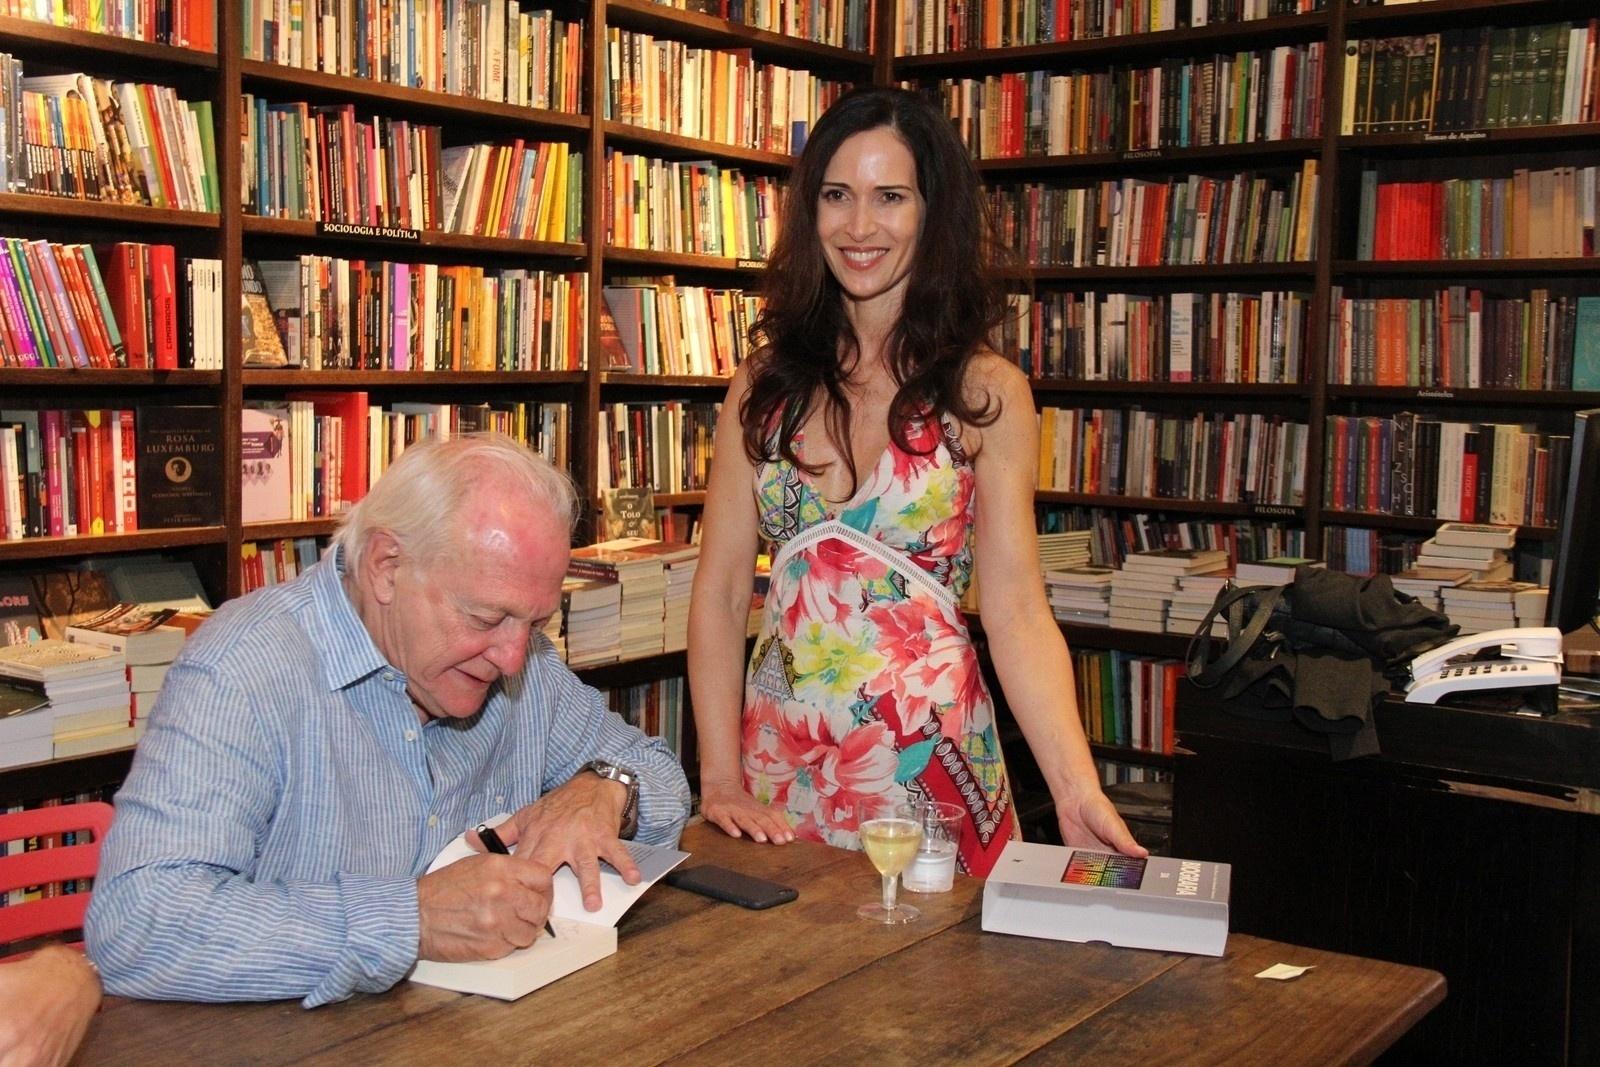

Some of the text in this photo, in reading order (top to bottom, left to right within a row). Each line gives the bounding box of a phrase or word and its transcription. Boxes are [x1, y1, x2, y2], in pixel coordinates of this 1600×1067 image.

[323, 223, 418, 240] SOCIOLOGIA E POLÍTICA
[164, 296, 173, 350] CAMARADAS
[166, 434, 195, 442] ROSA
[146, 444, 215, 454] LUXEMBURG
[1254, 505, 1296, 515] FILOSOFIA
